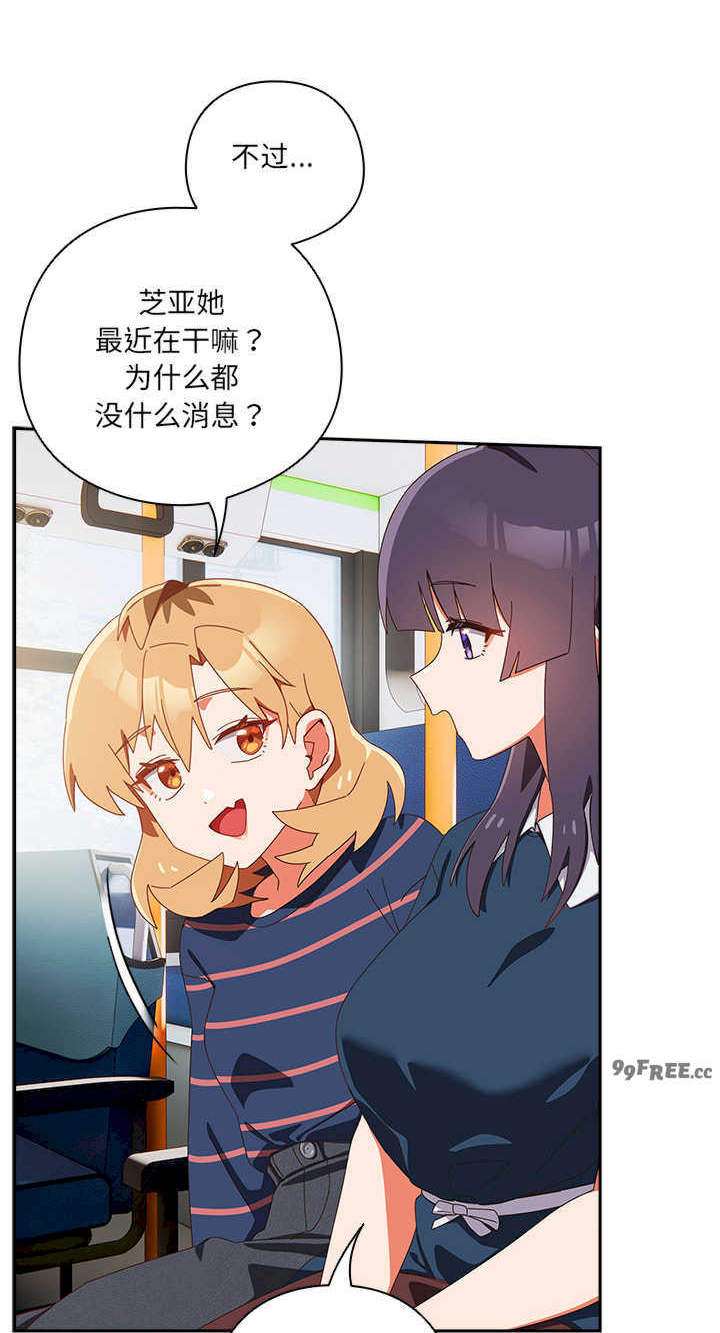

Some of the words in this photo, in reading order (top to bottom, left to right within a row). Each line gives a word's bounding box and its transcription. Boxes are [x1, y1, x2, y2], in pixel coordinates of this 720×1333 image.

[232, 143, 313, 170] 不过...
[139, 289, 225, 316] 芝亚她
[95, 327, 262, 355] 最近在干嘛？
[125, 363, 239, 391] 为什么都
[95, 401, 262, 429] 没什么消息？
